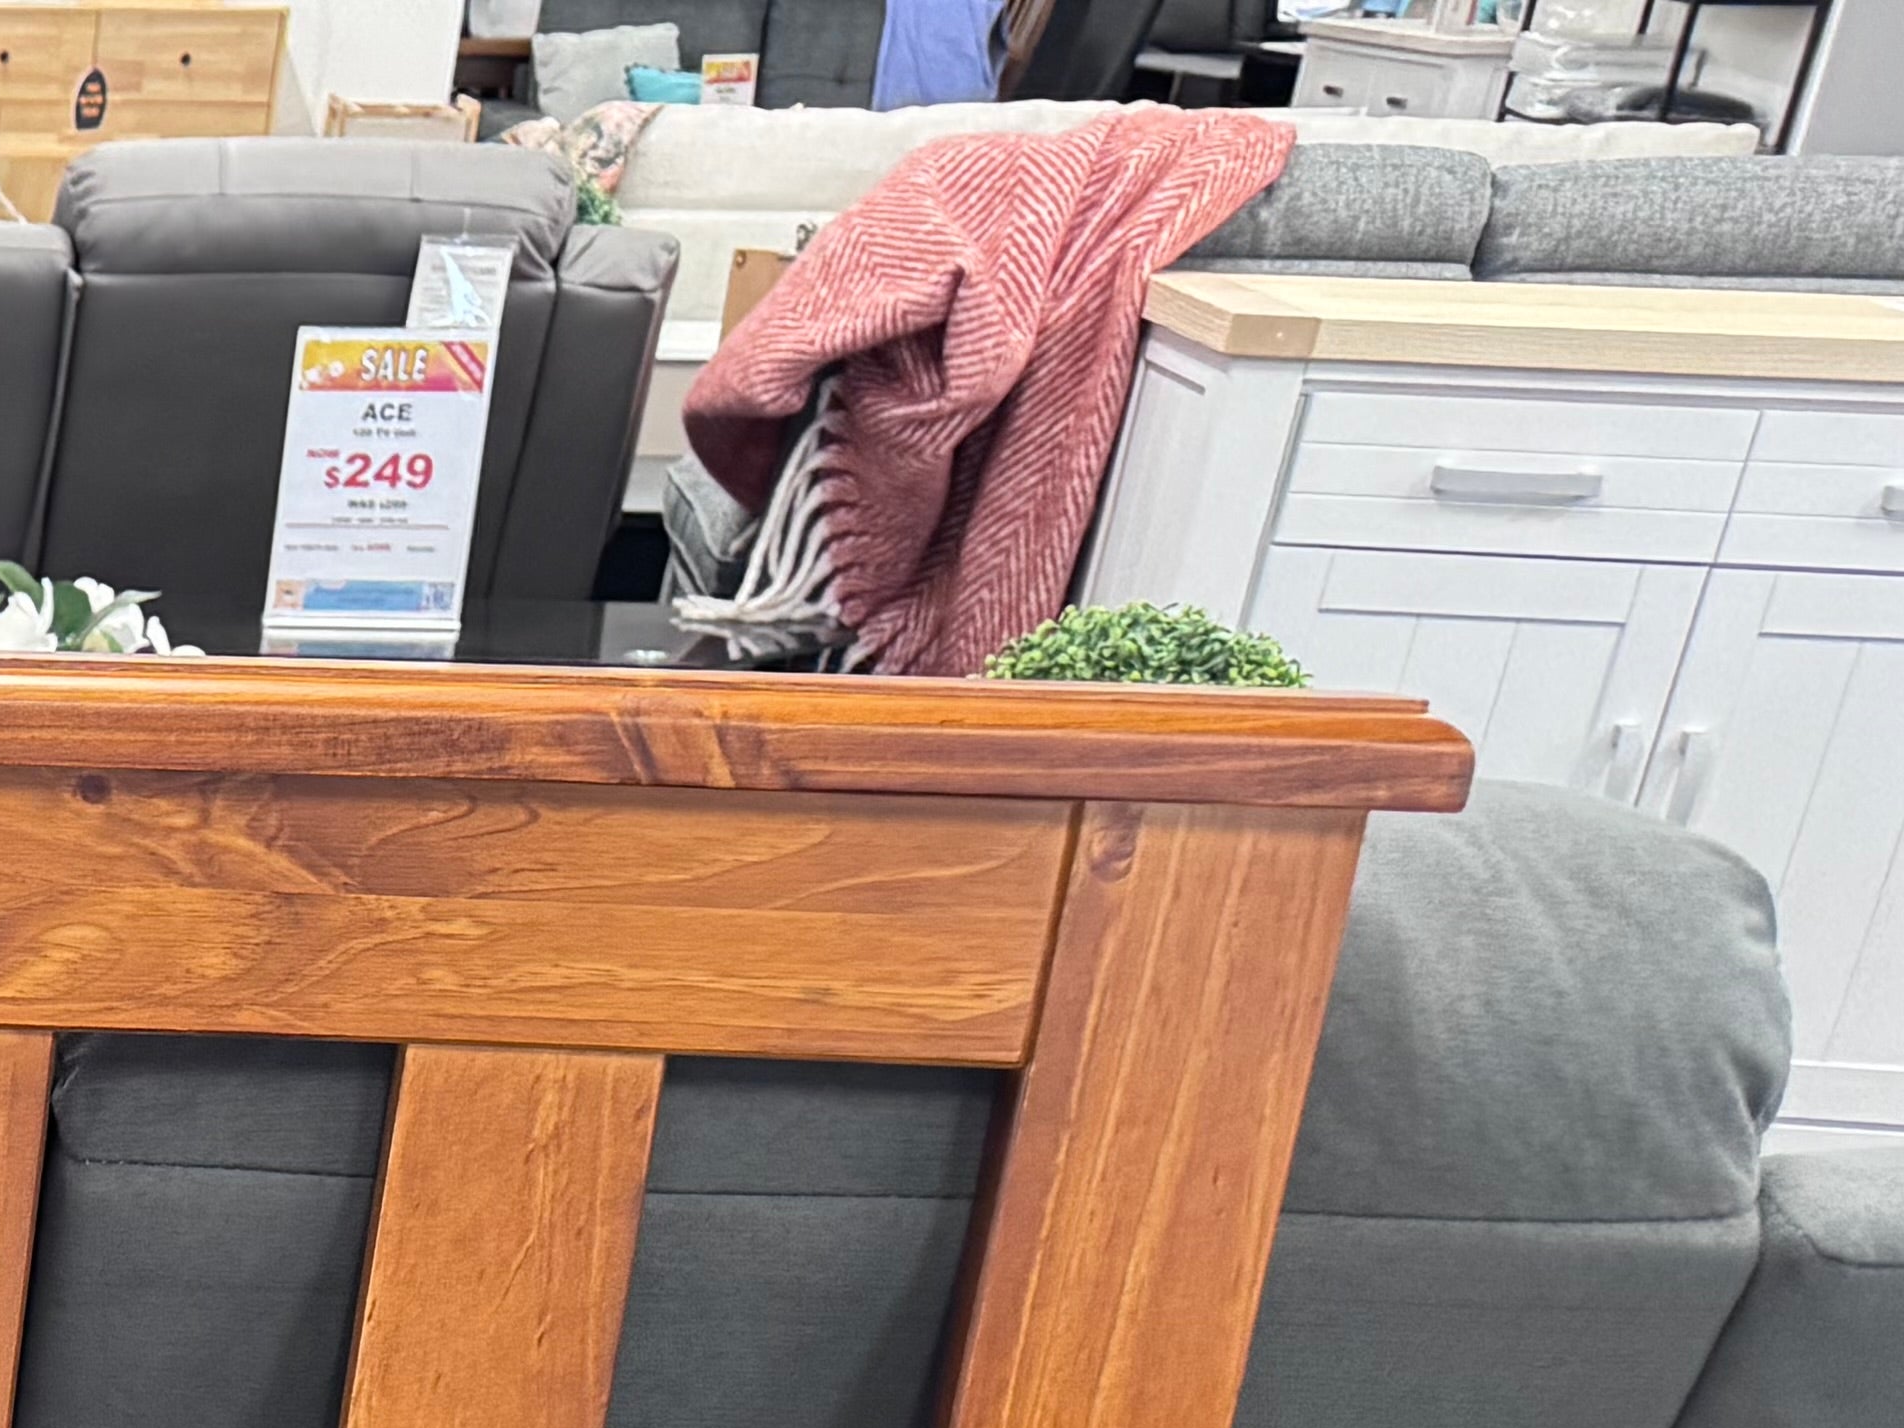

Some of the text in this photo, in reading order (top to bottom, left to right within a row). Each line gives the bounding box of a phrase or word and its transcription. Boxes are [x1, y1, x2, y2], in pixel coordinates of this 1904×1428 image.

[360, 347, 429, 382] SALE
[361, 403, 414, 422] ACE
[324, 452, 434, 490] $249
